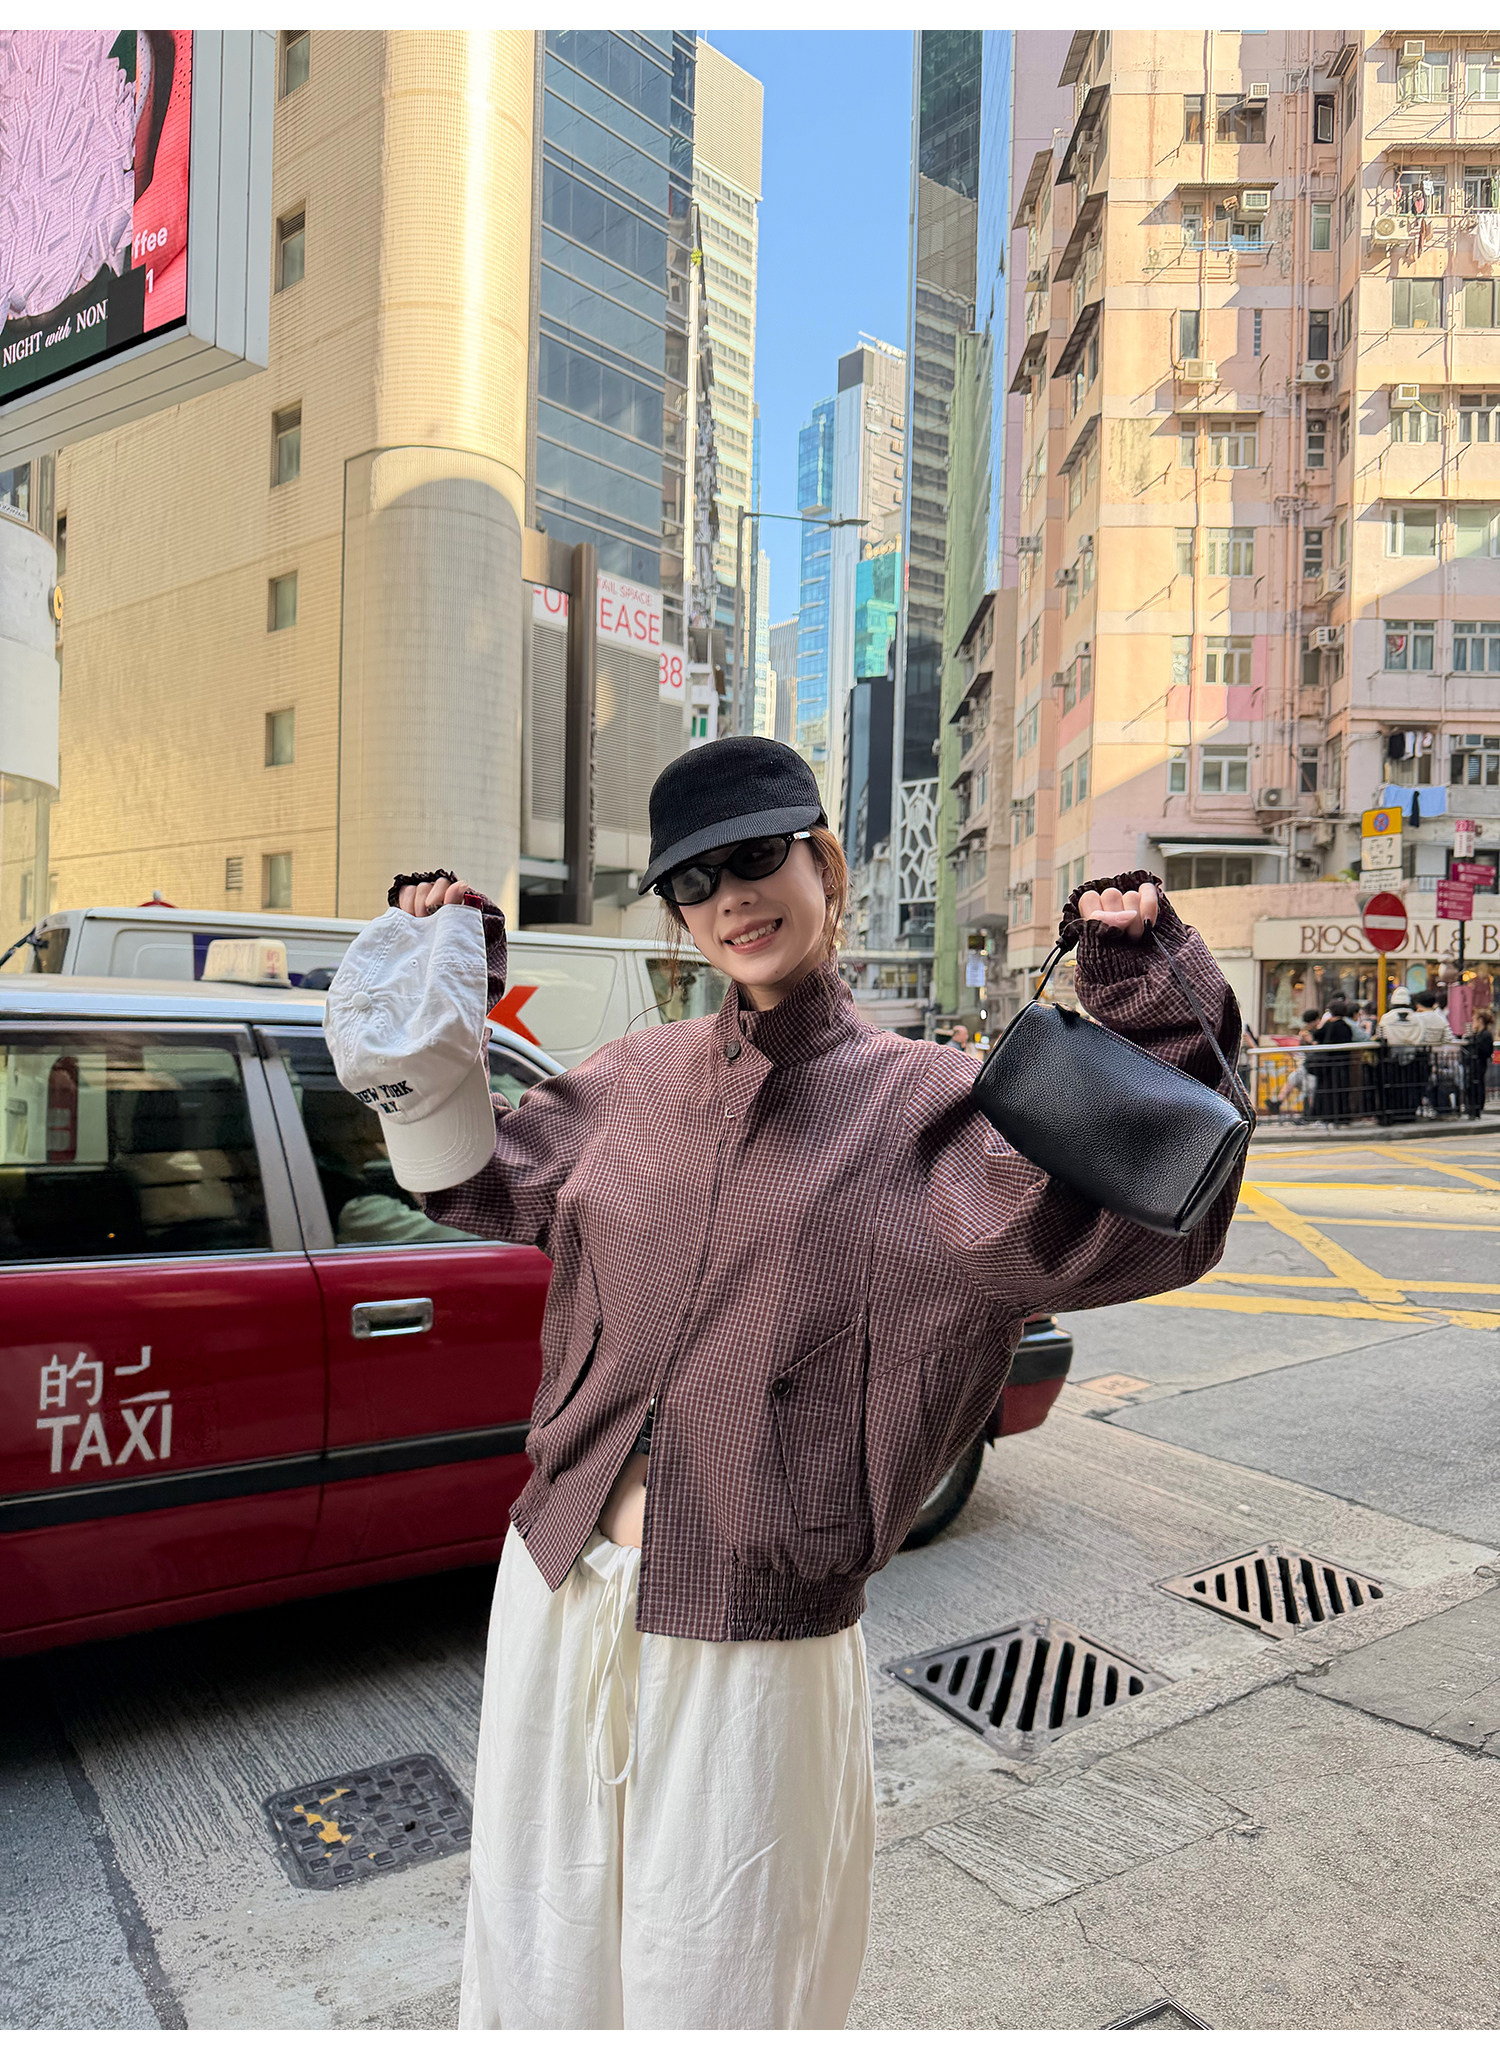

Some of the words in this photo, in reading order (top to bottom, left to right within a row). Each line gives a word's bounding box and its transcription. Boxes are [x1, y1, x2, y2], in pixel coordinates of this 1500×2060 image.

[131, 227, 168, 259] ffee
[2, 331, 43, 367] NIGHT
[45, 317, 73, 348] with
[75, 299, 109, 334] NON
[620, 583, 652, 606] SPACE
[600, 597, 660, 645] EASE
[378, 1079, 414, 1098] YORK
[36, 1404, 173, 1474] TAXI
